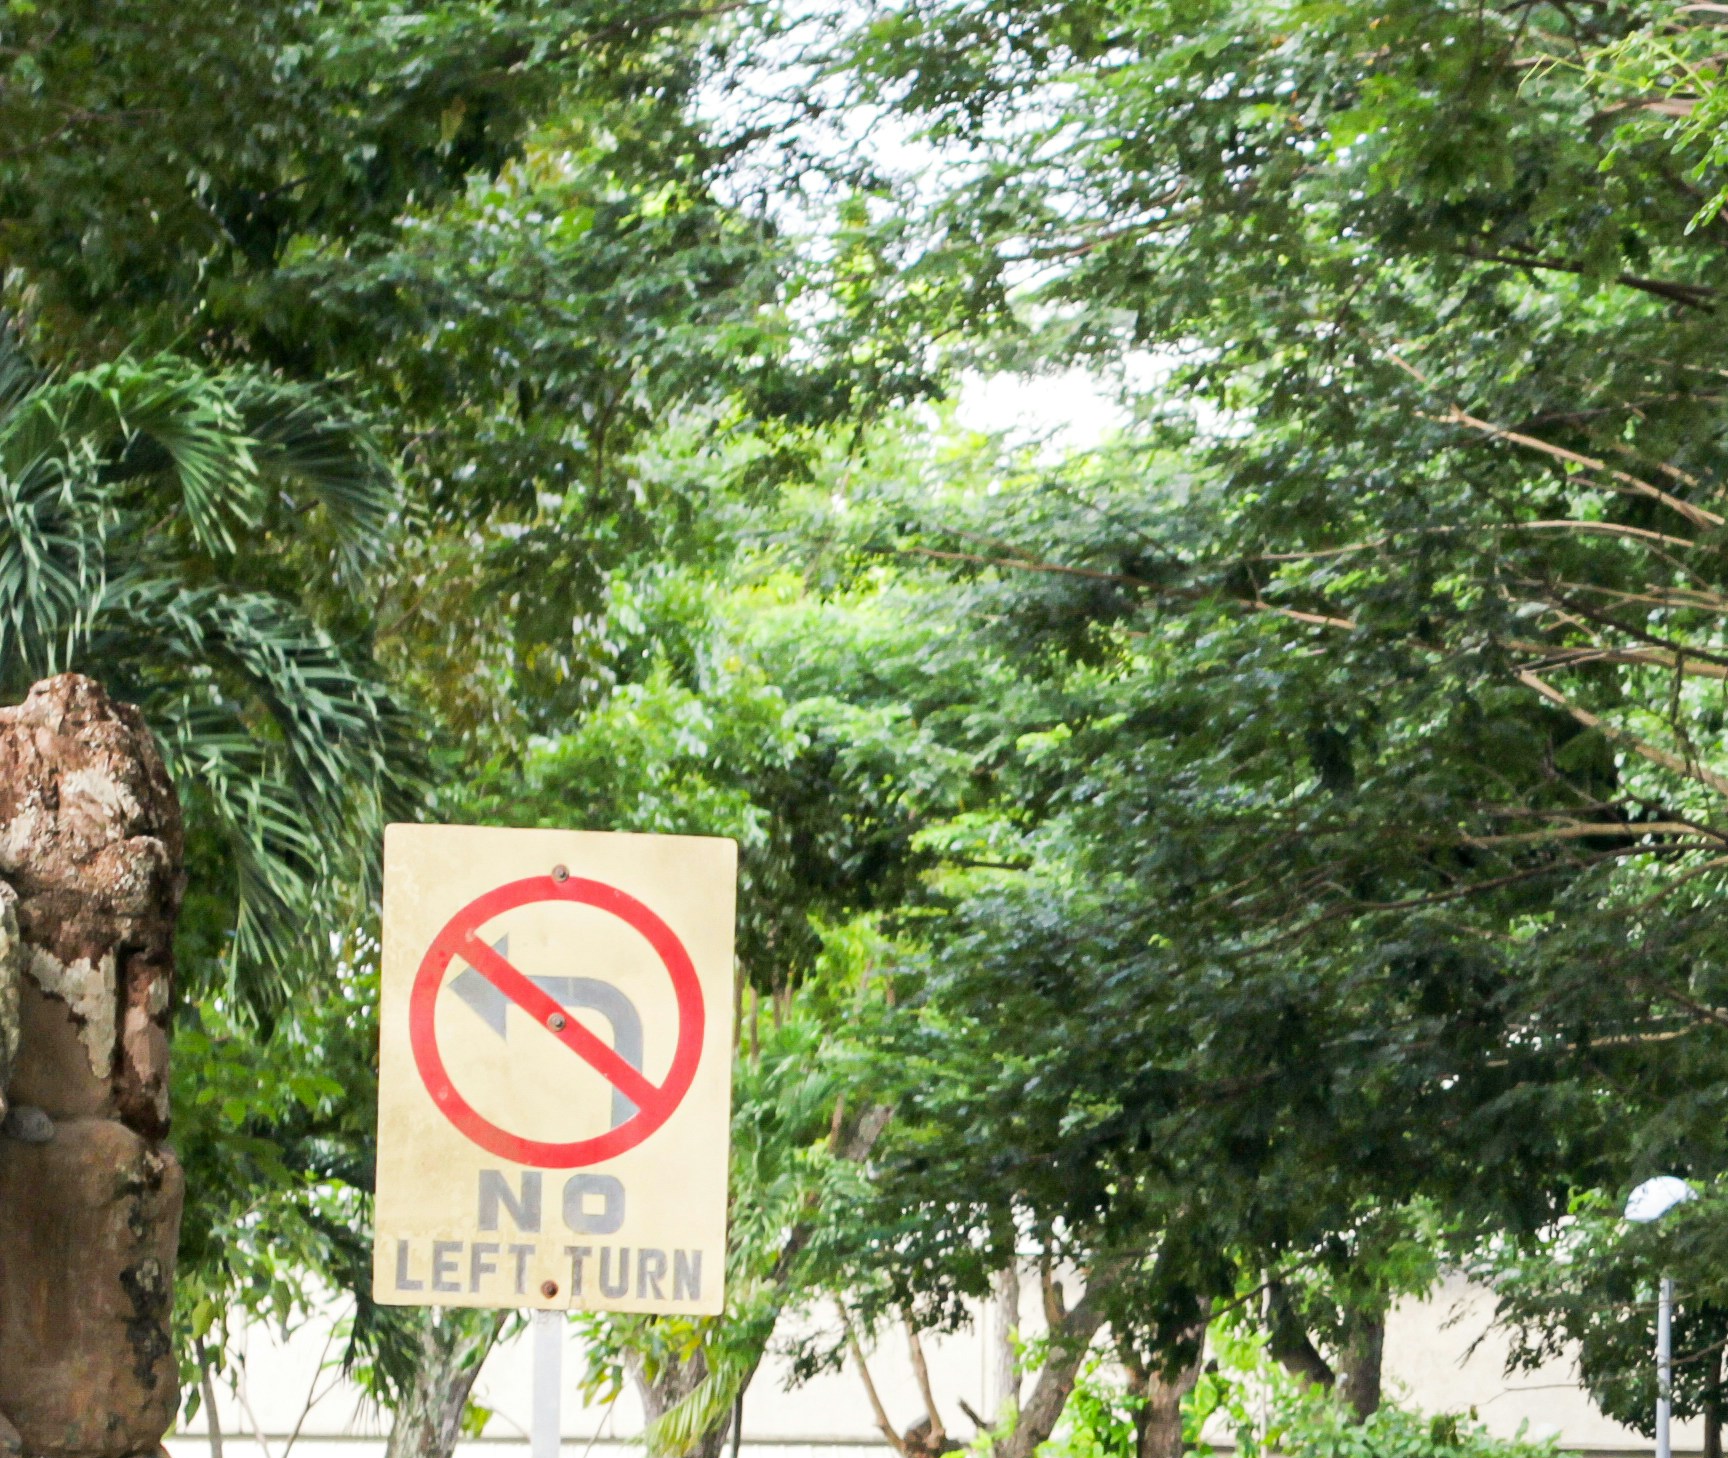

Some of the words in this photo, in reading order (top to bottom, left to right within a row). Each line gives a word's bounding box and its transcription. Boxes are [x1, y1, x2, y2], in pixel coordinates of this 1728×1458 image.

[477, 1169, 626, 1236] NO
[394, 1238, 536, 1294] LEFT
[562, 1245, 703, 1302] TURN
